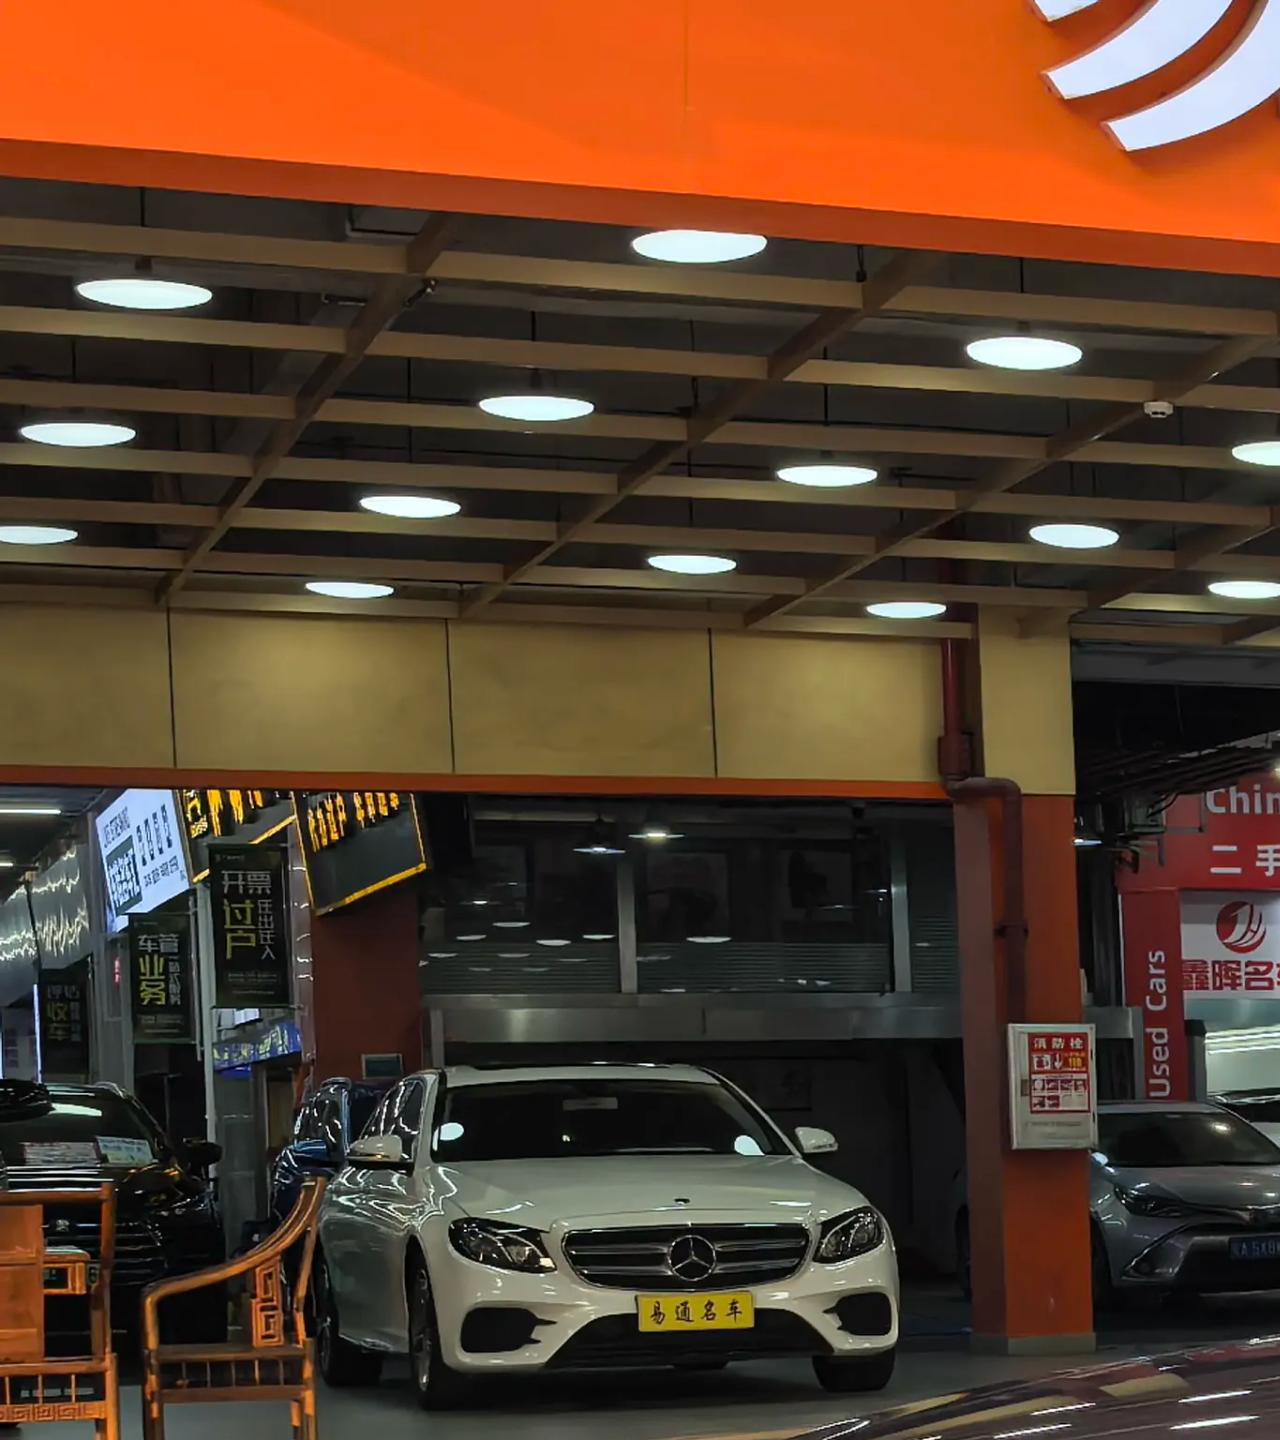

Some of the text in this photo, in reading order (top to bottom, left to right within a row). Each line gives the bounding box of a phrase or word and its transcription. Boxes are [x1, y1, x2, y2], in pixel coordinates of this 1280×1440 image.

[222, 870, 273, 895] 开票
[138, 953, 167, 1006] 业务
[1145, 949, 1172, 1098] Used Cars
[650, 1298, 743, 1326] 易通名车
